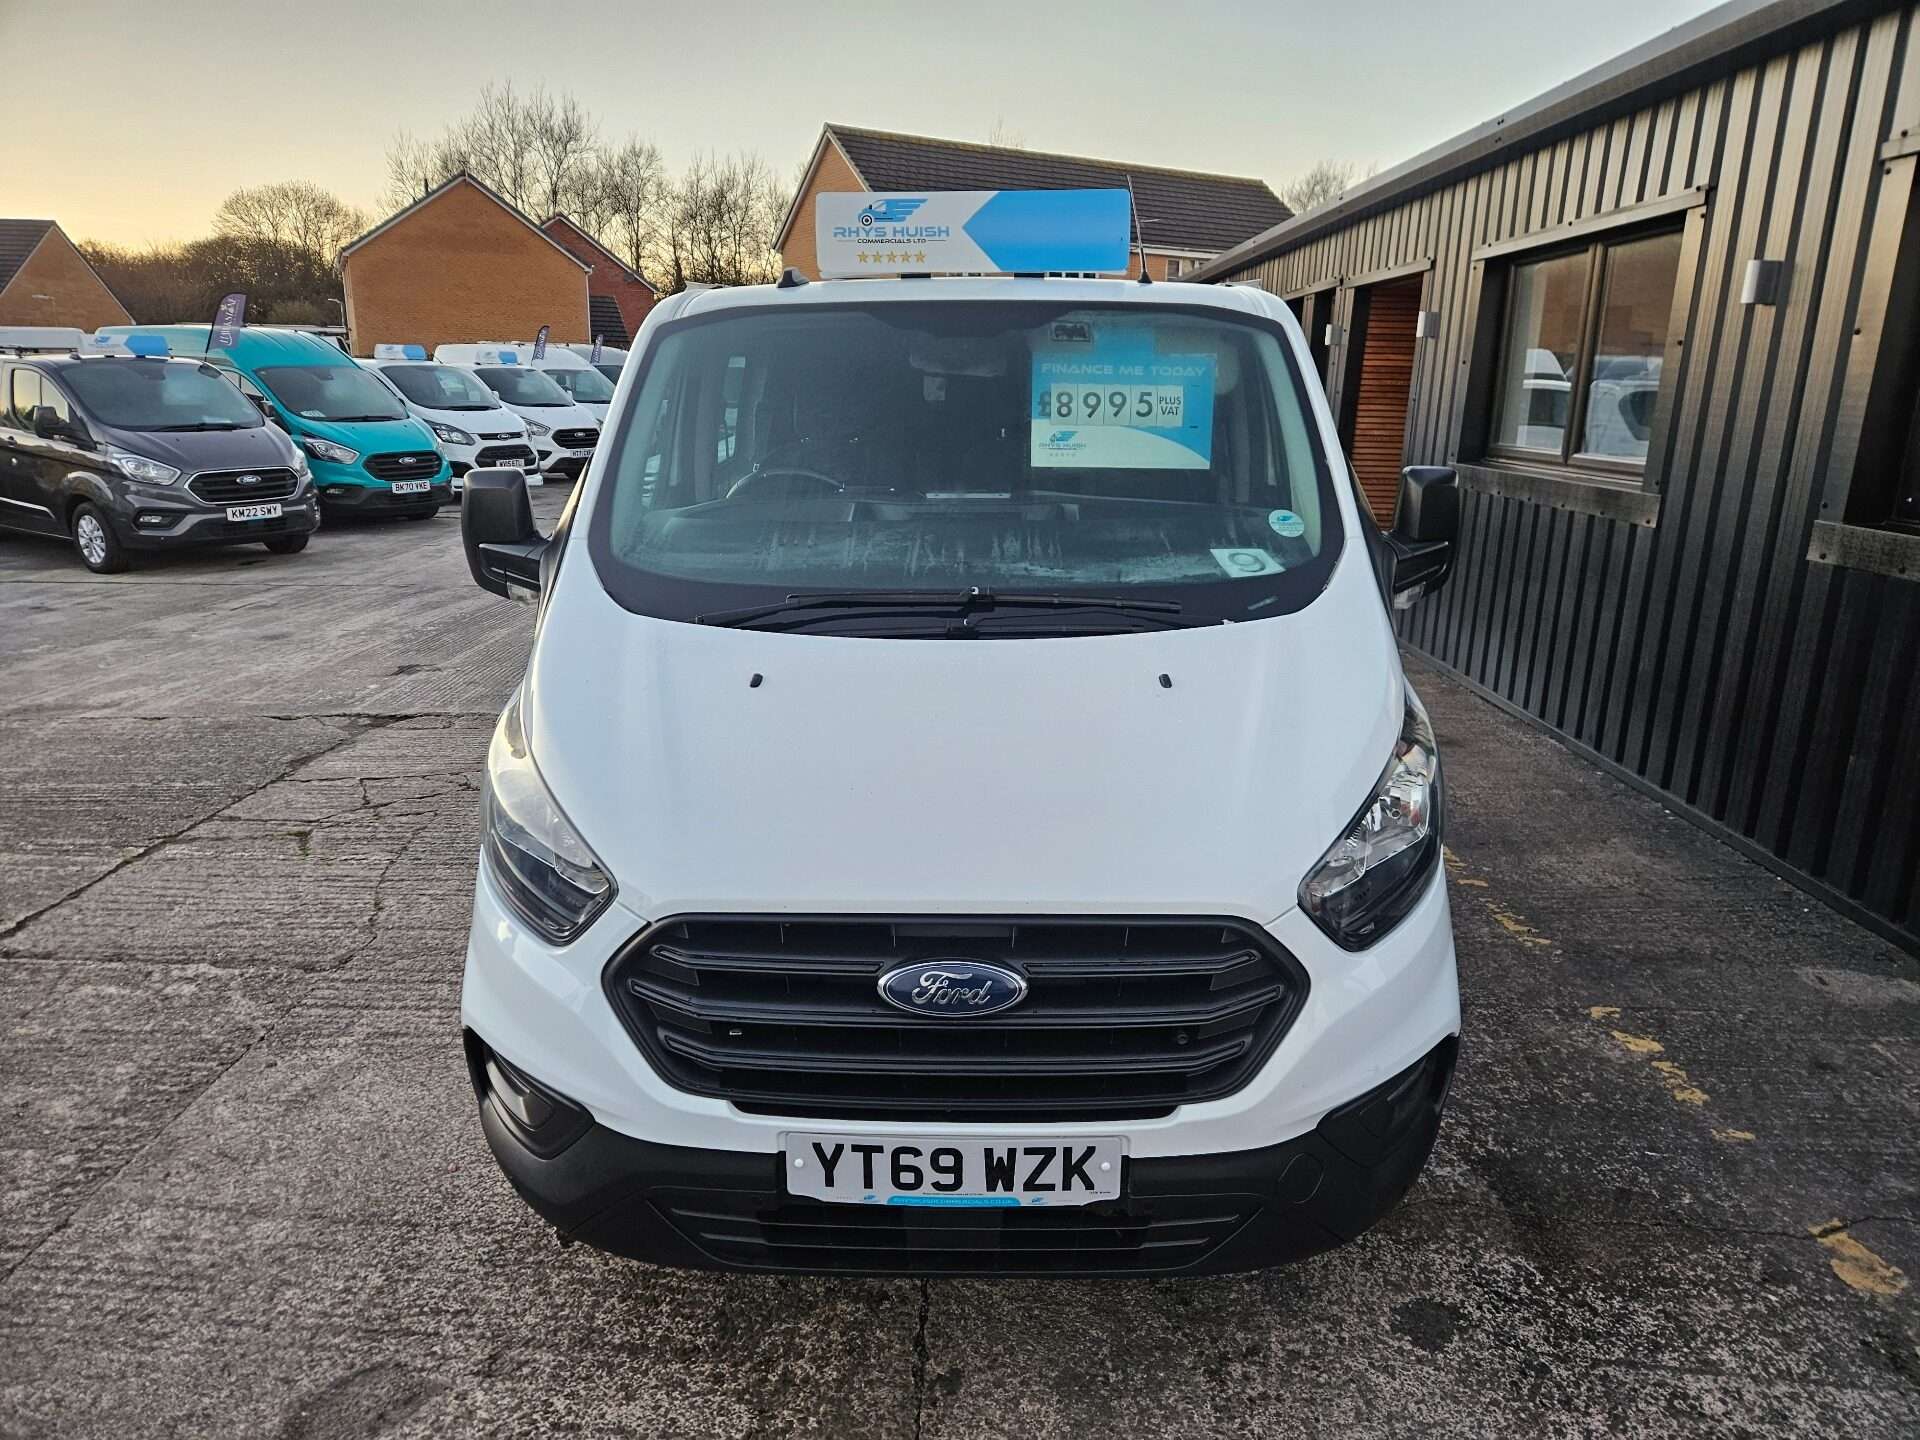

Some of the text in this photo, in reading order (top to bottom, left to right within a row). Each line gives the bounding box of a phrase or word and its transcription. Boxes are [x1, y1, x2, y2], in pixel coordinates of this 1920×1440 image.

[833, 226, 950, 238] RHYS HUISH
[1040, 363, 1206, 377] FINANCE ME TODAY
[1159, 395, 1182, 405] PLUS
[1161, 406, 1180, 416] VAT
[395, 481, 427, 491] BK70 VKE
[231, 505, 277, 518] KM22 SWY
[911, 971, 992, 1005] Ford
[812, 1141, 1097, 1192] YT69 WZK
